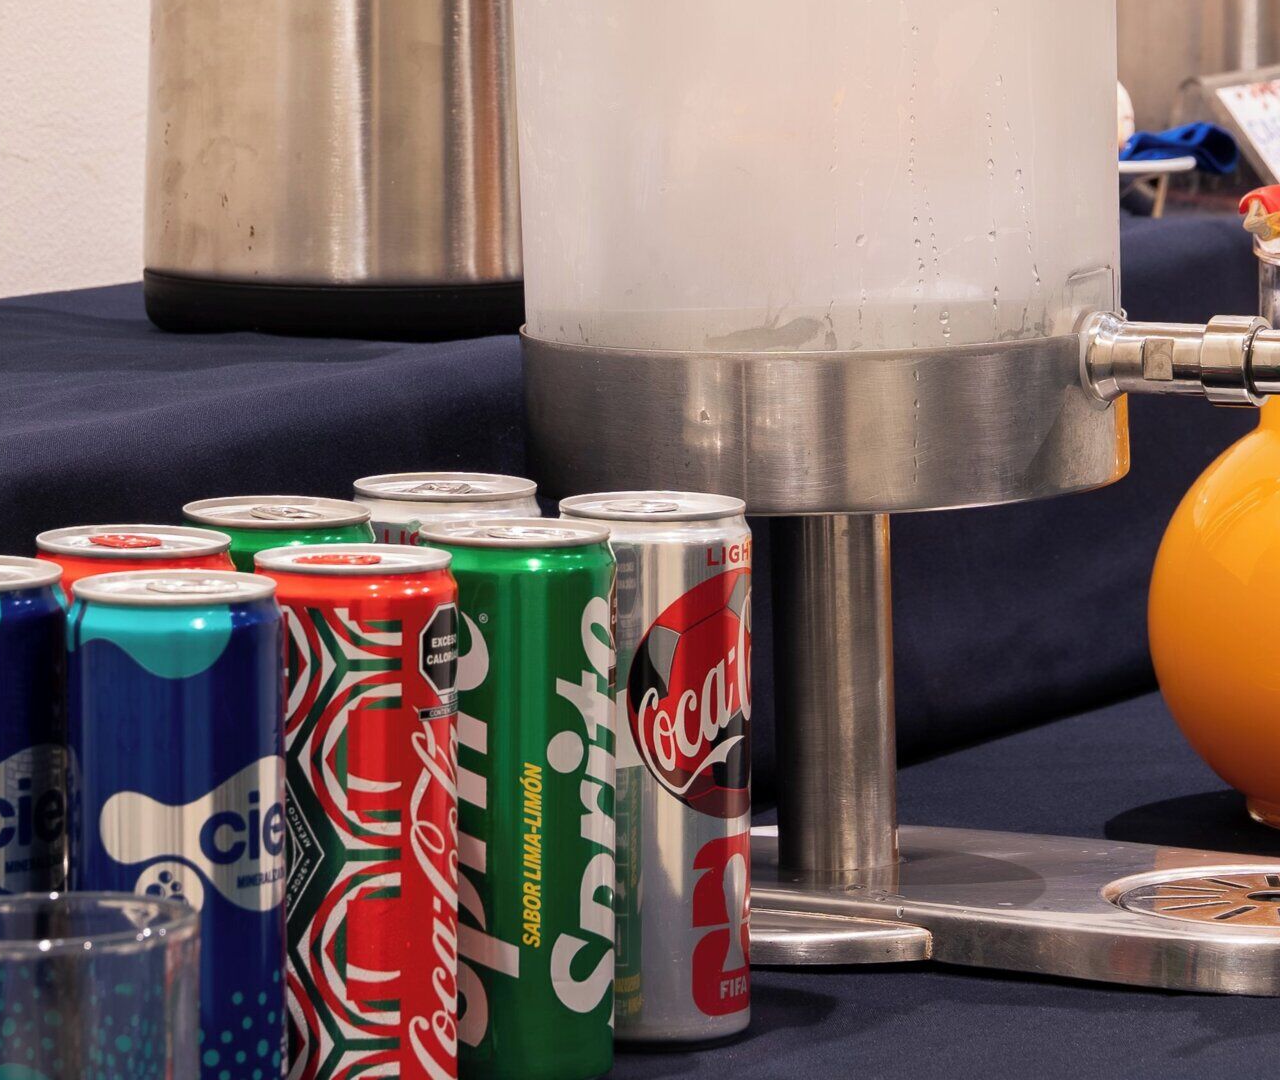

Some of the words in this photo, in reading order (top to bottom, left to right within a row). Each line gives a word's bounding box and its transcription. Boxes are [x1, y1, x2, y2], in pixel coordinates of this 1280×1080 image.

[523, 762, 543, 874] LIMA-LIMÓN
[522, 876, 542, 949] SABOR
[719, 980, 747, 1000] FIFA
